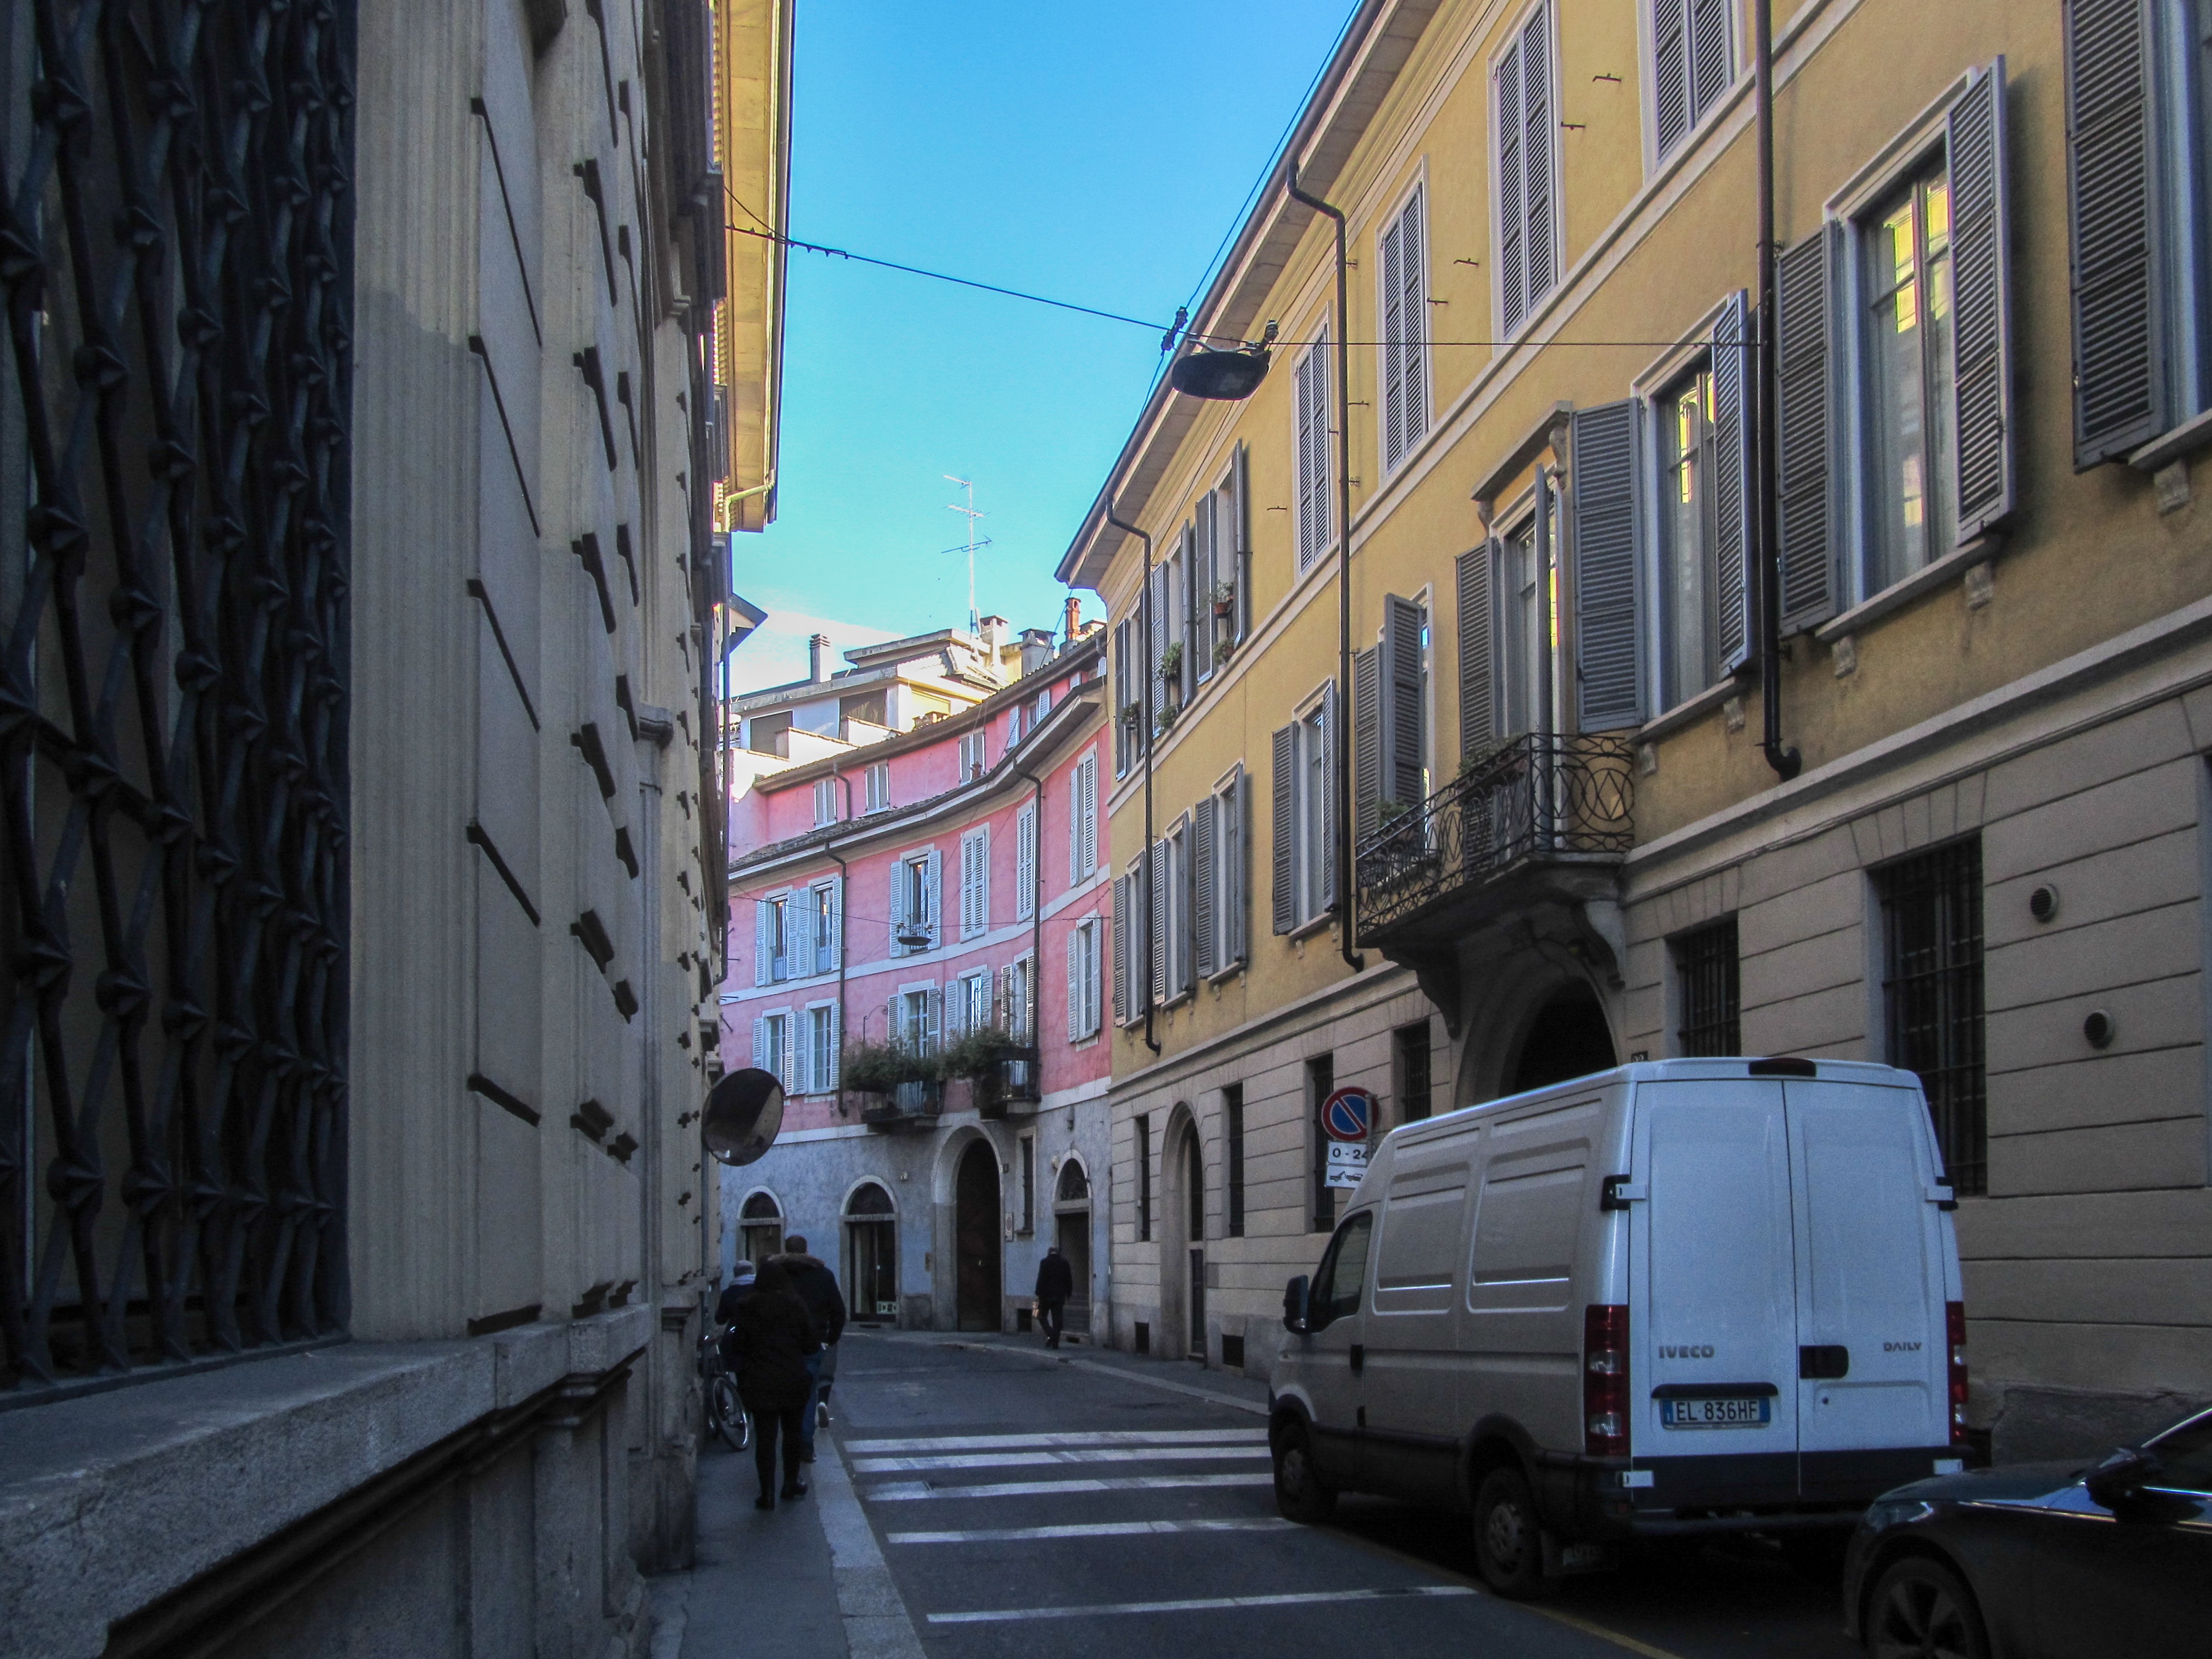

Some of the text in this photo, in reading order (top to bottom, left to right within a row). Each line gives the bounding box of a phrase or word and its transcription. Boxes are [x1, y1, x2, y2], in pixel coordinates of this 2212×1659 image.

[1659, 1345, 1715, 1358] IVECO
[1883, 1342, 1922, 1351] DAILY
[1676, 1401, 1757, 1421] EL 836HF
